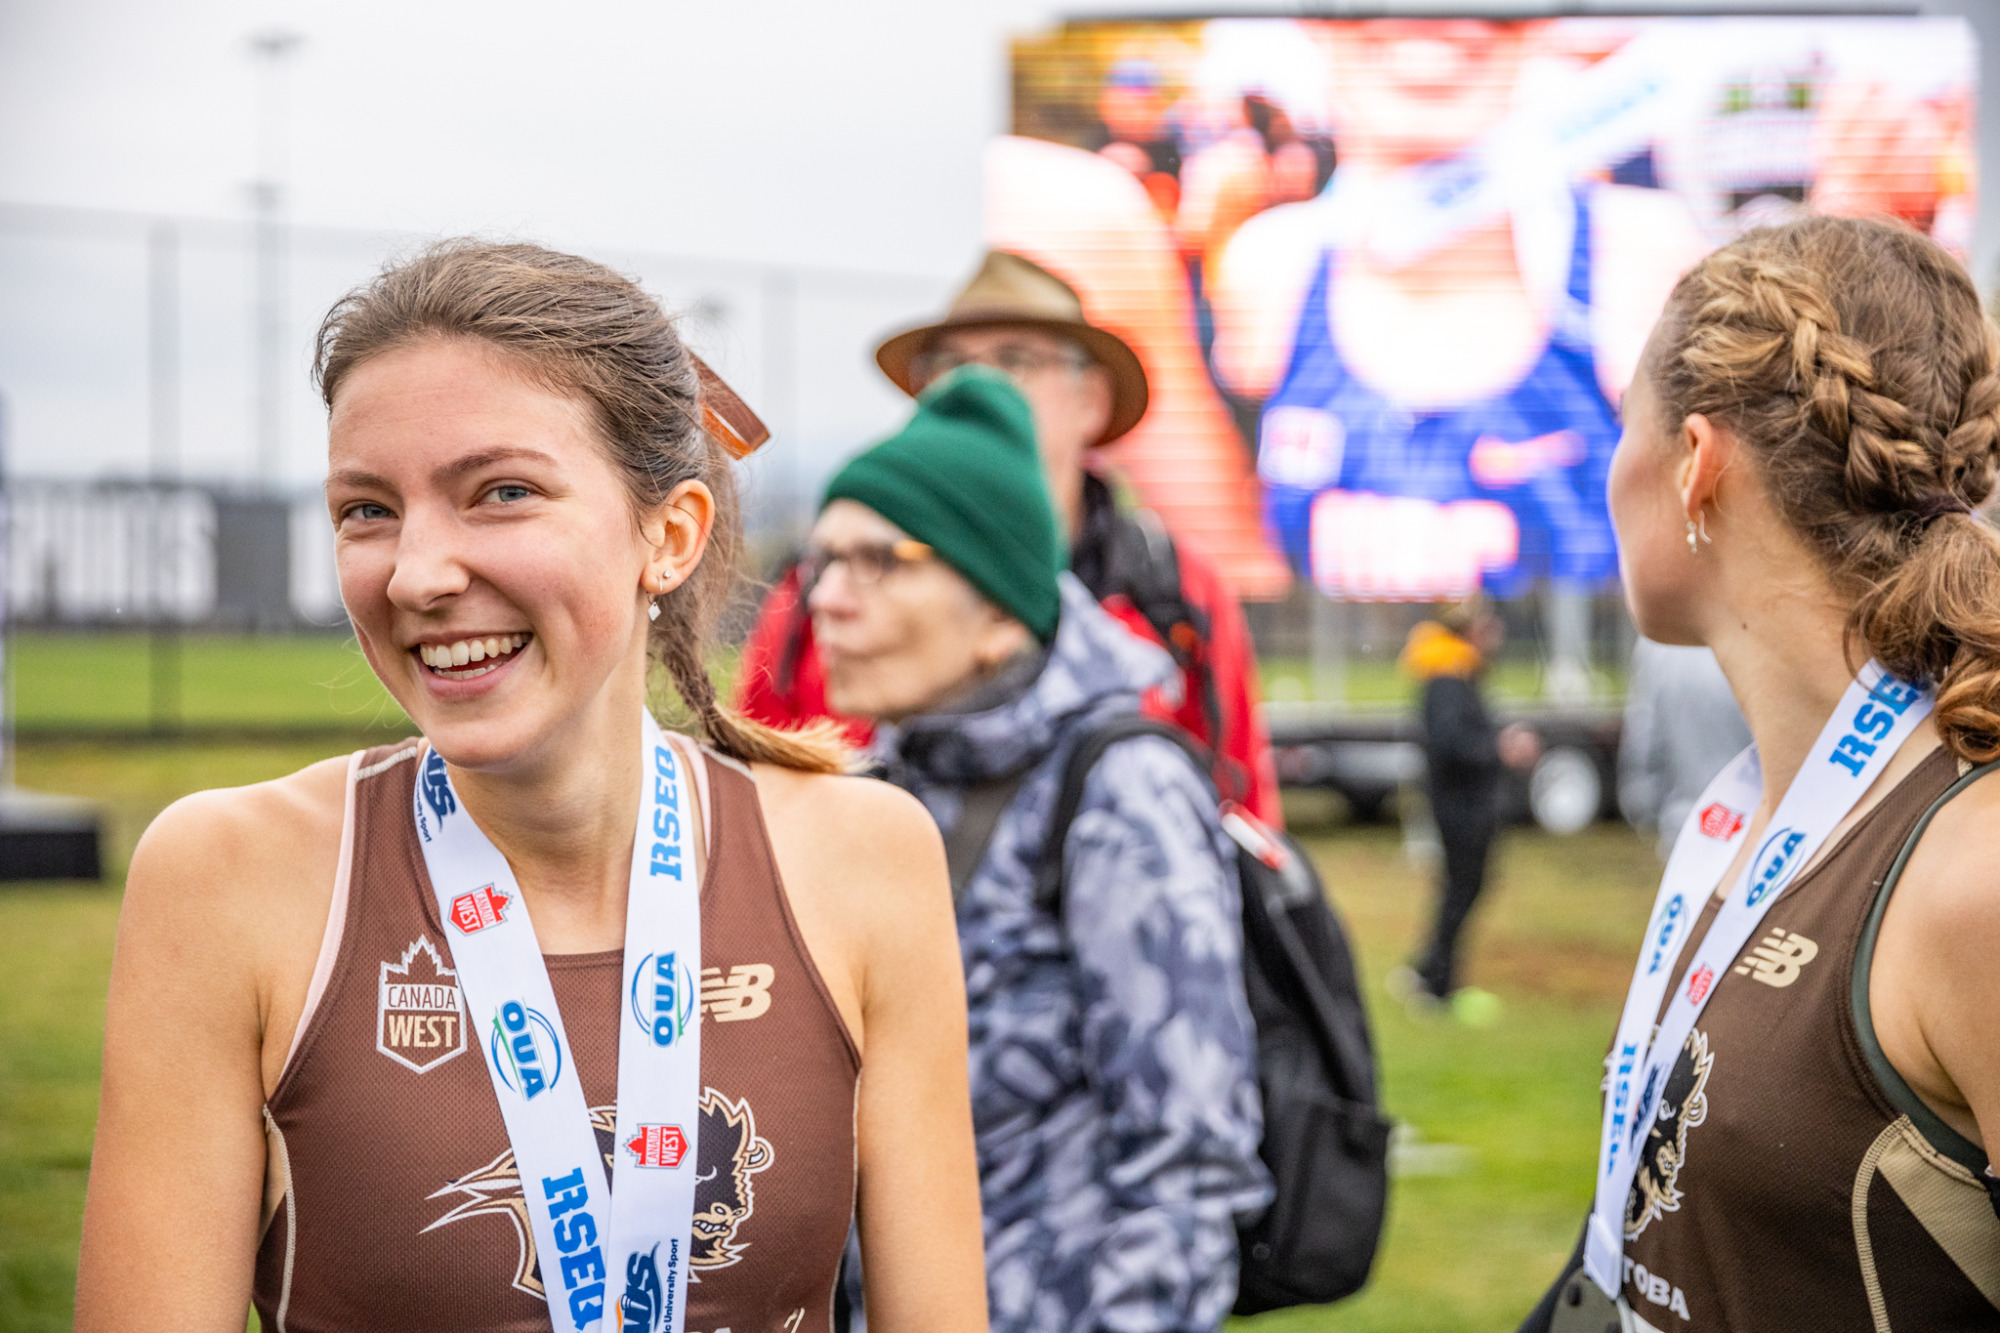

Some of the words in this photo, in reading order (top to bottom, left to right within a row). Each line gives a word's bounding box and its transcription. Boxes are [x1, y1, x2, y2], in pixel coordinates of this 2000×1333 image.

[1829, 672, 1920, 778] RSE
[650, 745, 682, 881] RSEQ
[1746, 832, 1806, 907] OUA
[456, 896, 481, 930] WEST
[474, 891, 495, 926] CANADA
[388, 986, 457, 1010] CANADA
[654, 951, 676, 1047] OUA
[388, 1015, 457, 1047] WEST
[501, 1000, 548, 1101] OUA
[647, 1127, 660, 1165] CANADA
[660, 1127, 680, 1165] WEST
[668, 1238, 680, 1268] Sport
[664, 1267, 678, 1324] University
[1624, 1254, 1691, 1322] TOBA
